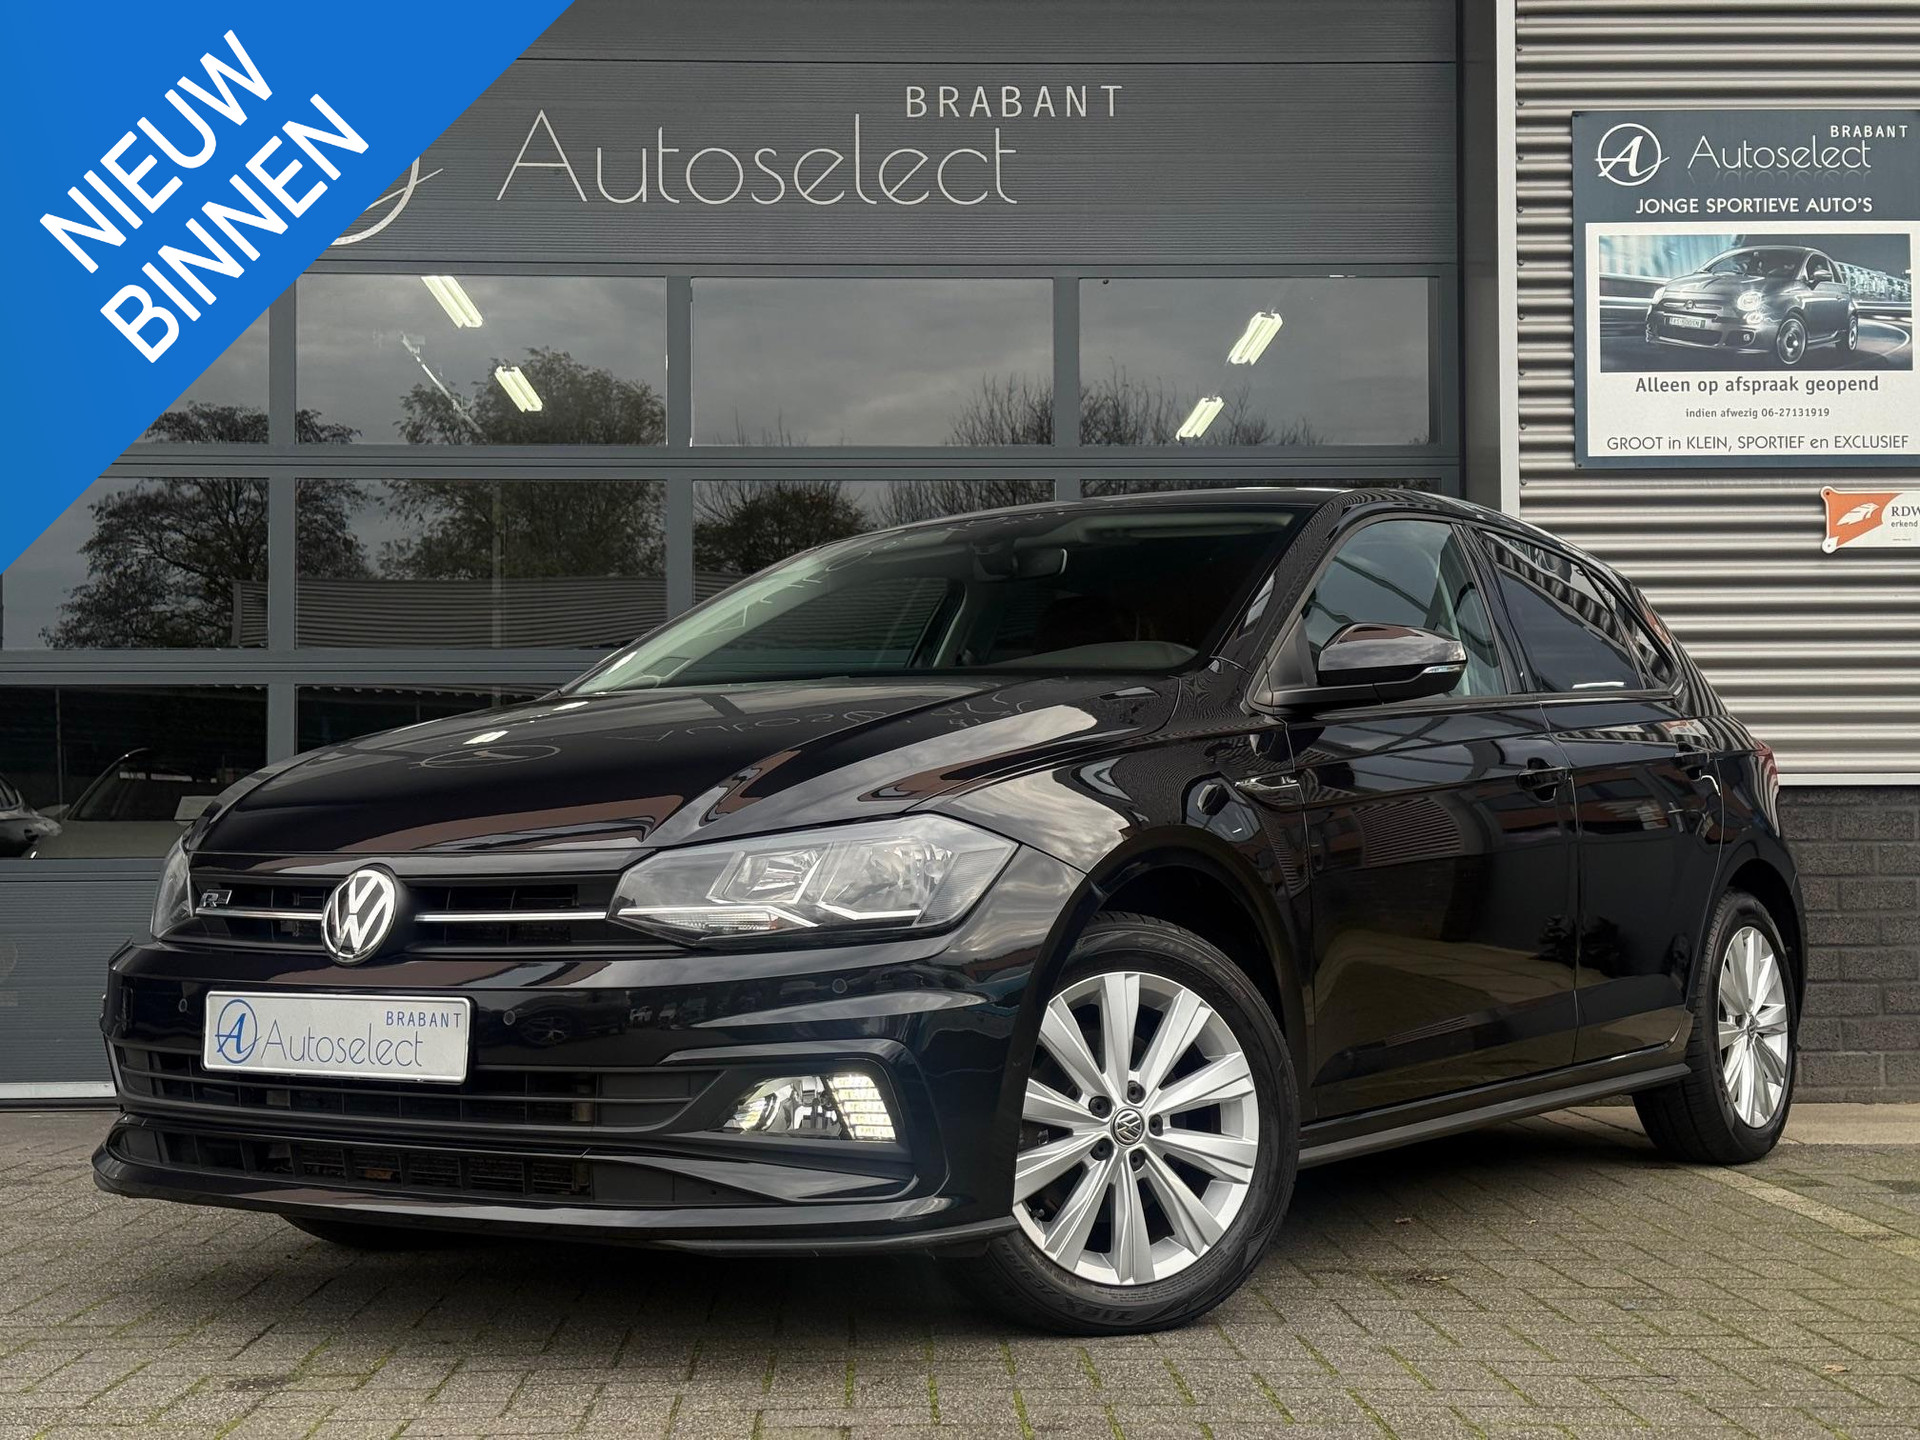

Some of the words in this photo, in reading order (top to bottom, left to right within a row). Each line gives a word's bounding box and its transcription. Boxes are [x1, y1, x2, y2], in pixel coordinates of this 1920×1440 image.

[906, 85, 1123, 117] BRABANT
[1830, 125, 1909, 138] BRABANT
[497, 110, 1018, 205] Autoselect
[1687, 135, 1872, 169] Autoselect
[1636, 198, 1699, 214] JONGE
[1706, 198, 1800, 213] SPORTIEVE
[1806, 197, 1873, 213] AUTO'S
[1635, 377, 1690, 393] Alleen
[1697, 381, 1718, 396] op
[1725, 376, 1799, 395] afspraak
[1805, 376, 1879, 395] geopend
[1685, 408, 1717, 418] indien
[1720, 407, 1758, 419] afwezig
[1761, 407, 1830, 418] 06-27131919
[1606, 436, 1662, 450] GROOT
[1668, 437, 1681, 450] in
[1686, 436, 1732, 452] KLEIN,
[1737, 435, 1805, 449] SPORTIEF
[1810, 438, 1829, 449] en
[1834, 434, 1909, 449] EXCLUSIEF
[1890, 519, 1918, 528] erkend
[385, 1011, 463, 1029] BRABANT
[261, 1020, 424, 1067] Autoselect
